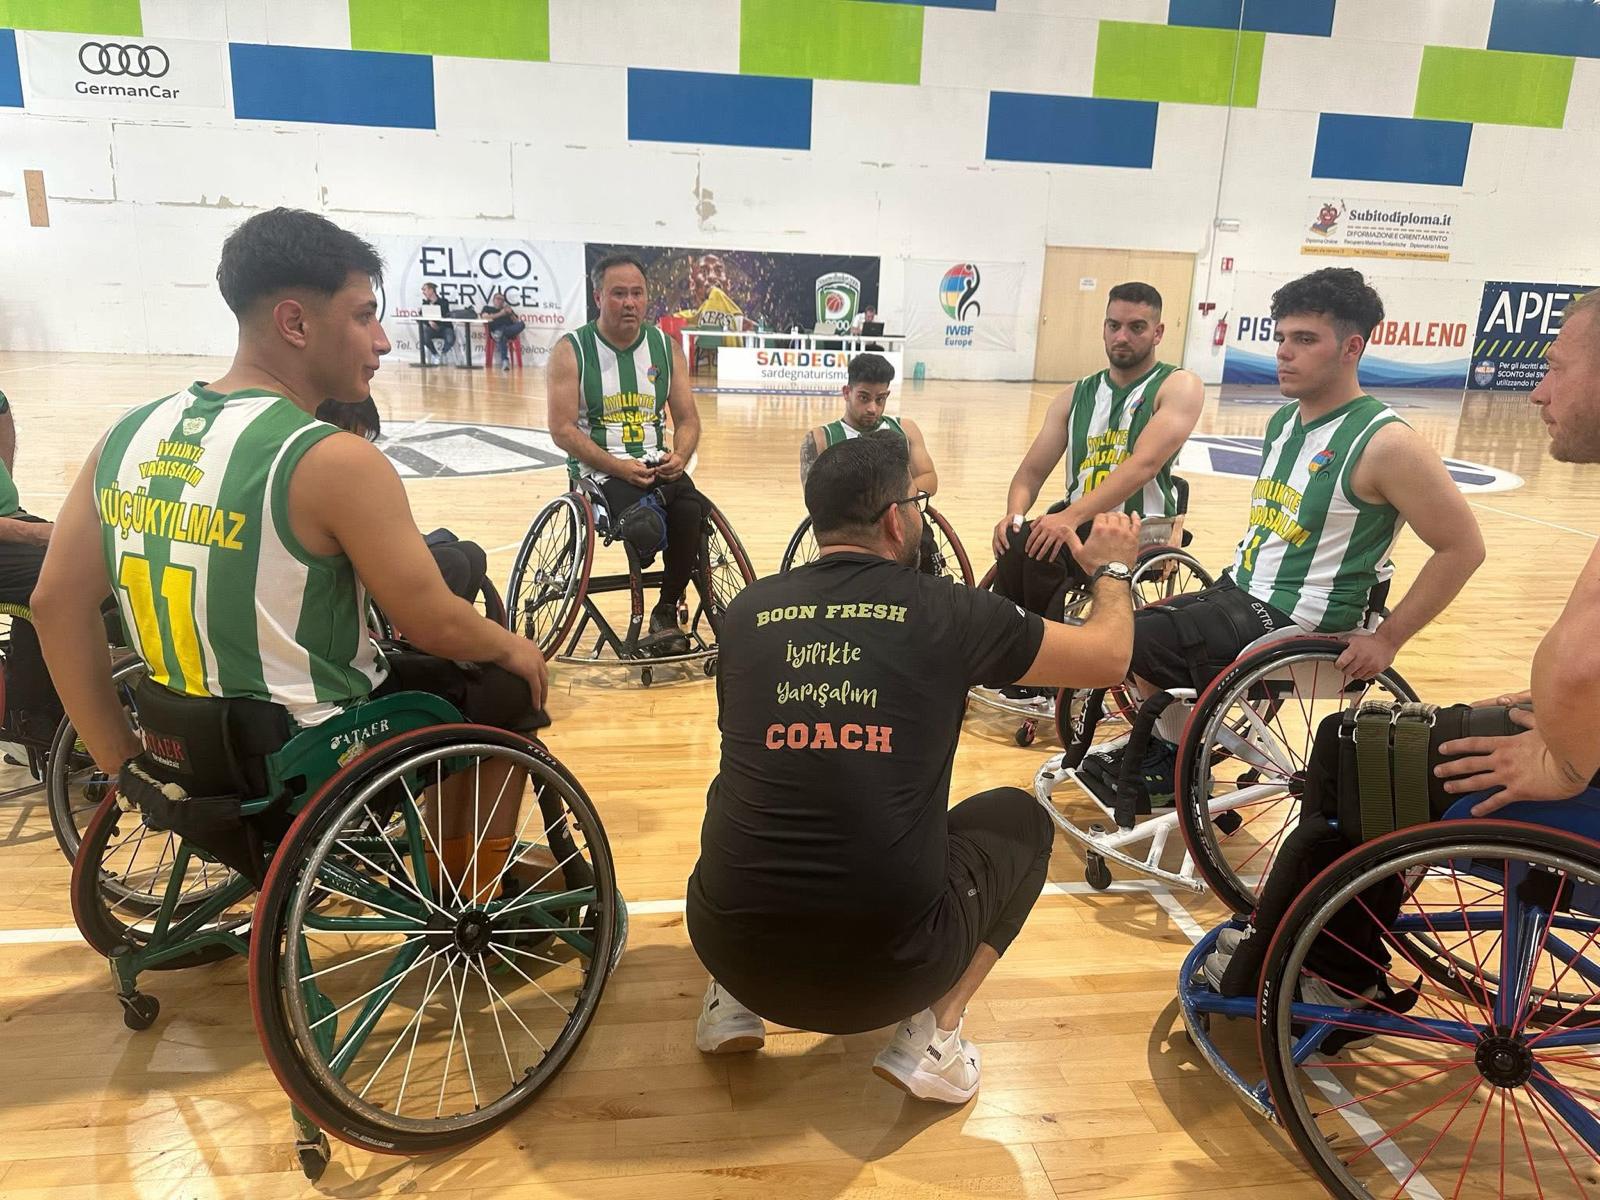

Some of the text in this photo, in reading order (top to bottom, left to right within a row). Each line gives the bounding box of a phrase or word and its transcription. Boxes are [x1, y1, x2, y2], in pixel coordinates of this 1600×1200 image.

[75, 81, 180, 99] GermanCar
[1349, 209, 1451, 226] Subitodiploma.it
[1399, 233, 1448, 242] ORIENTAMENTO
[419, 246, 538, 281] EL.CO.
[1483, 291, 1580, 334] APE
[944, 337, 972, 348] Europe
[945, 325, 974, 336] IWBF
[1497, 370, 1524, 378] SCONTO
[621, 423, 646, 443] 15
[139, 460, 205, 488] YARIŞALIM
[101, 481, 247, 551] KÜÇÜKYILMAZ
[1244, 535, 1262, 572] 1
[119, 552, 214, 698] 11
[756, 603, 908, 627] BOON FRESH
[1251, 602, 1275, 634] EXTRA
[786, 640, 861, 669] İyilikte
[765, 722, 893, 753] COACH
[1261, 980, 1270, 1025] KENDA
[926, 1044, 942, 1061] PUMA
